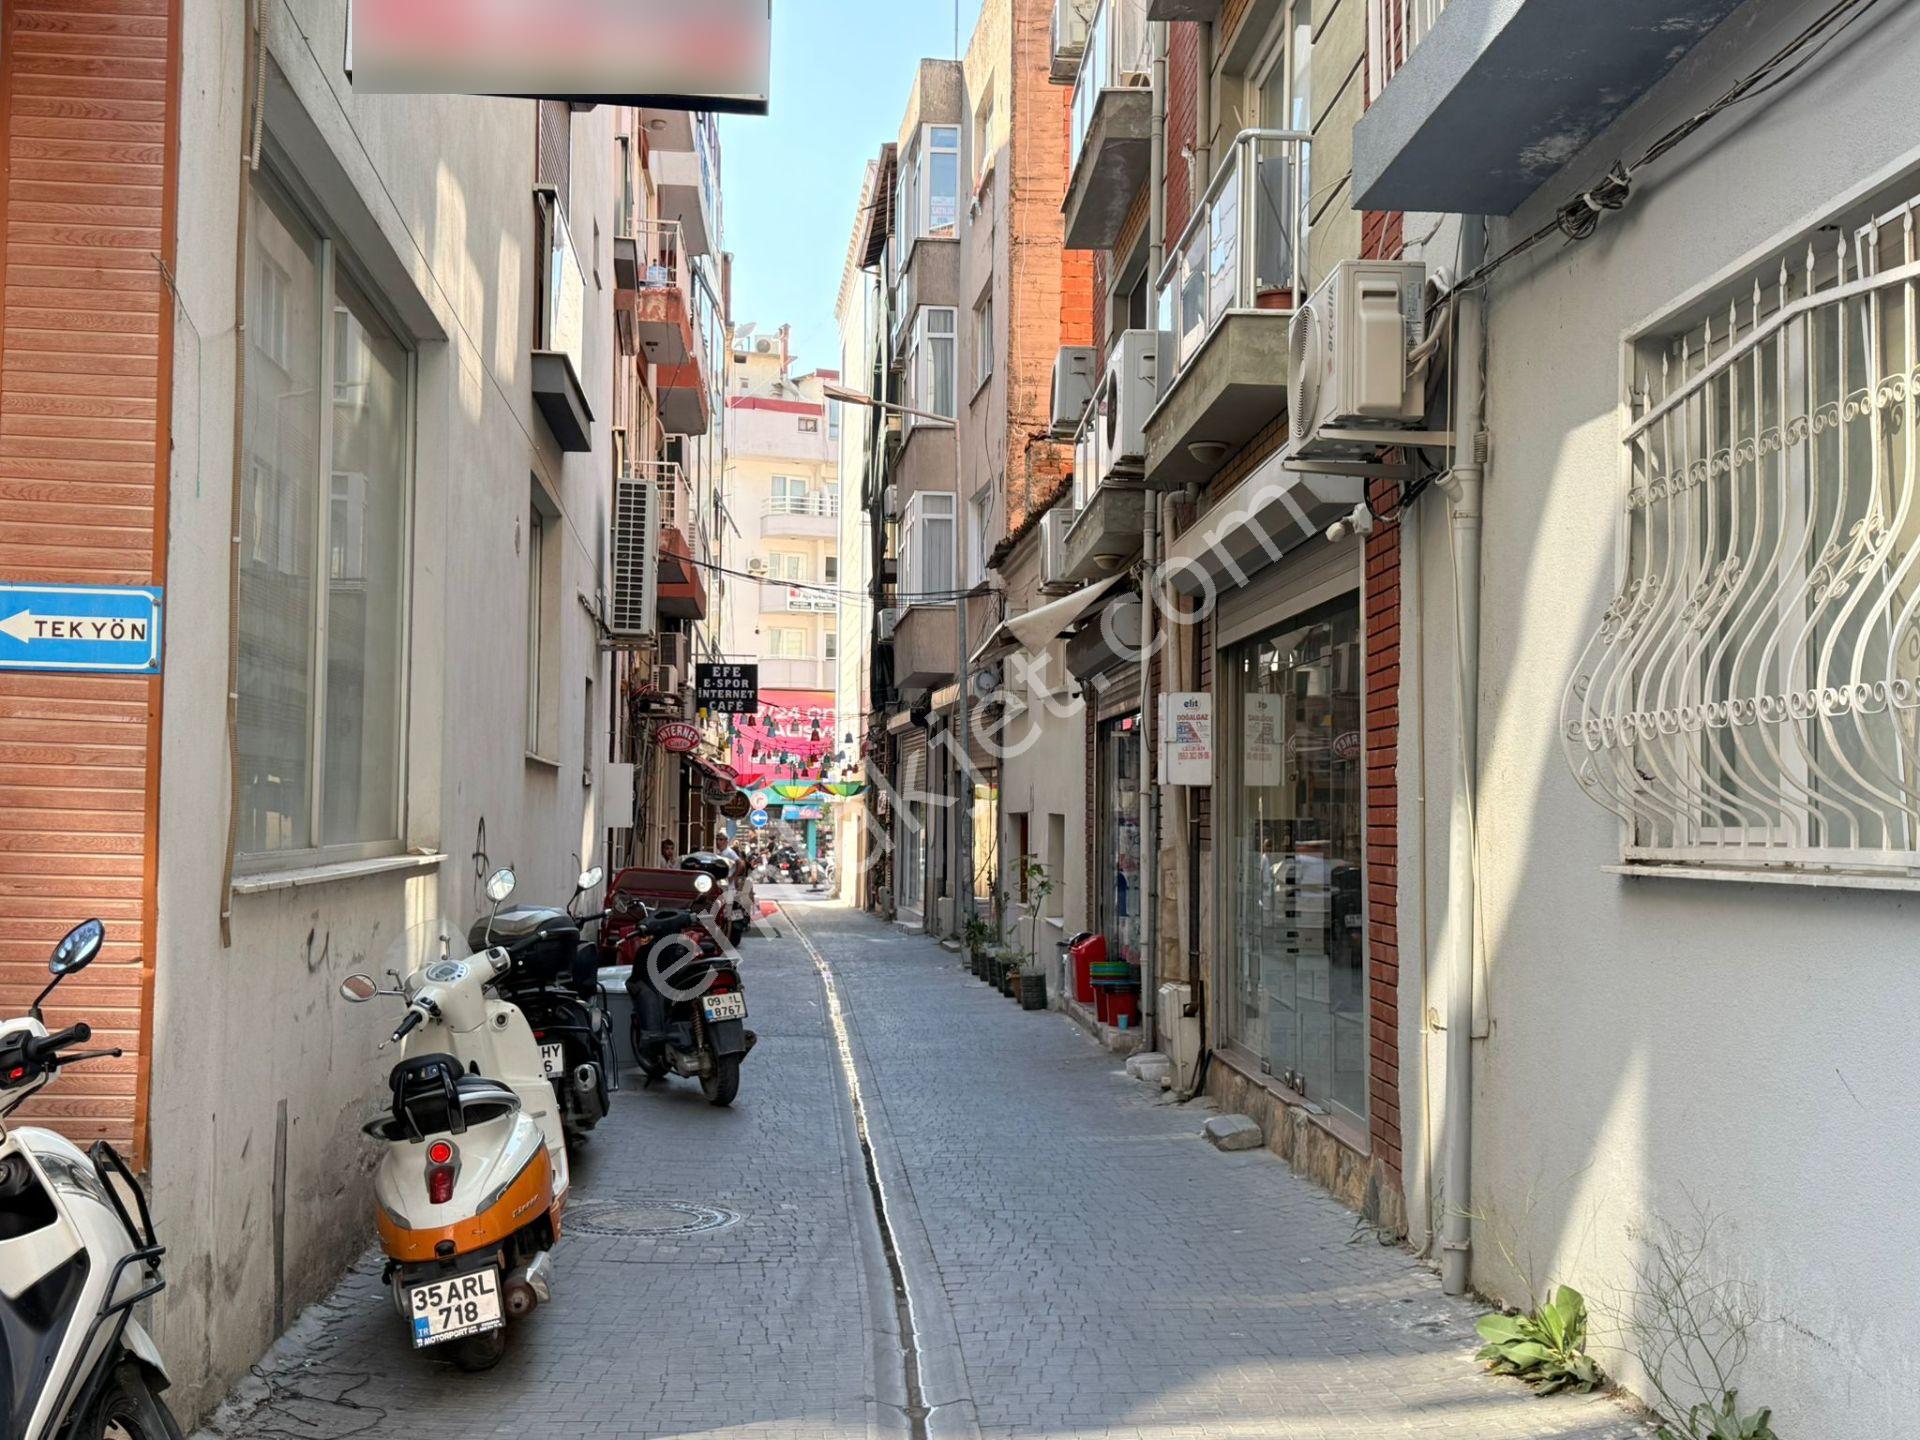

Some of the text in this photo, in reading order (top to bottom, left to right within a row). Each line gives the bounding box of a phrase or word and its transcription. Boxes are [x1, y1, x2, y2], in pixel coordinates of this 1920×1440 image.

[34, 619, 145, 639] TEK YÖN
[712, 666, 741, 677] EFE
[698, 688, 754, 698] İNTERNET
[715, 1004, 741, 1016] 8767
[413, 1274, 494, 1311] 35 ARL
[439, 1301, 478, 1329] 718
